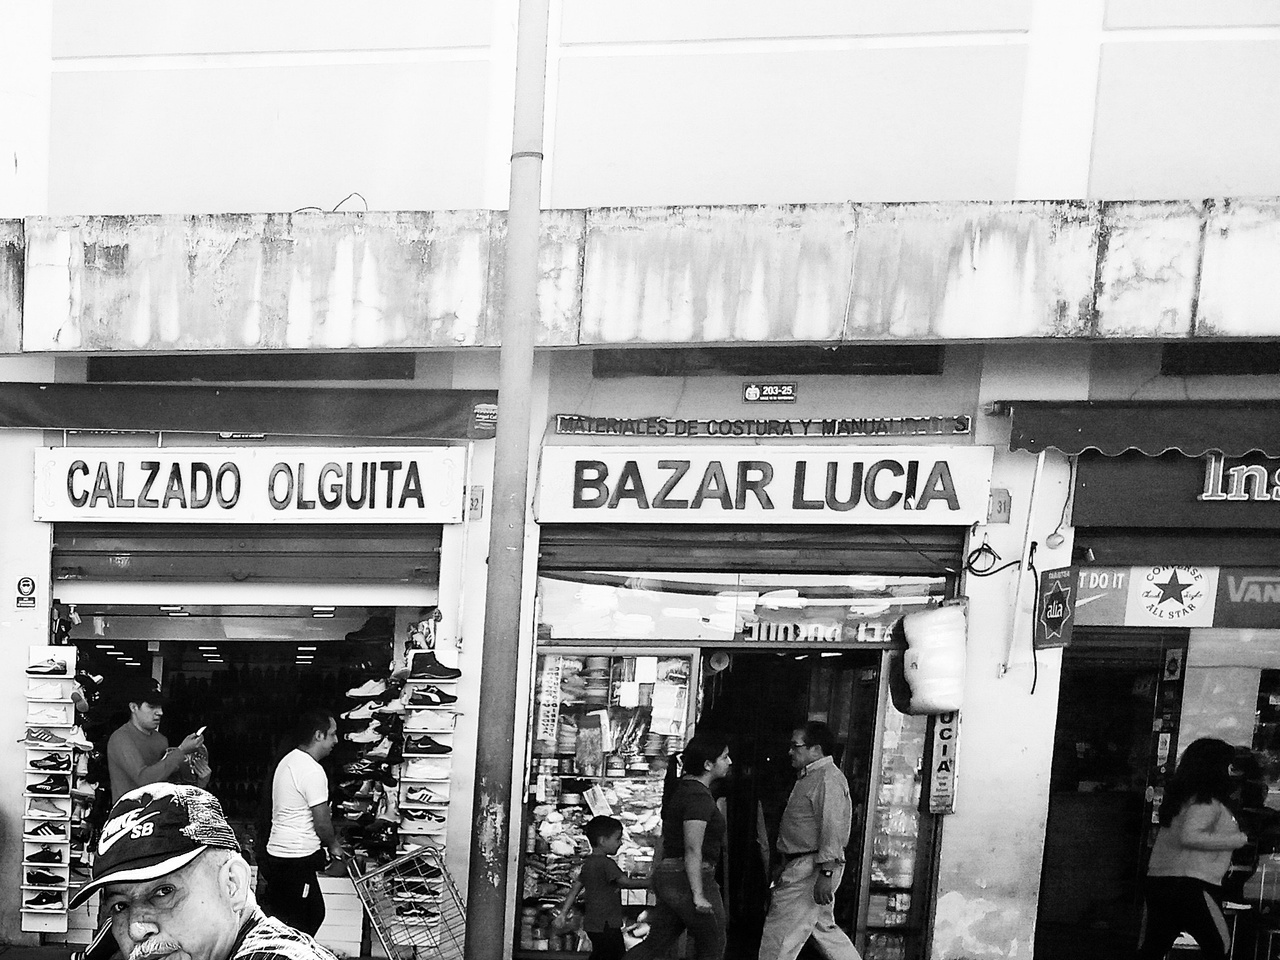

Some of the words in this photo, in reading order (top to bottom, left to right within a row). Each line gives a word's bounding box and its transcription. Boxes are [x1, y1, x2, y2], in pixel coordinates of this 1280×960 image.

[762, 385, 793, 395] 203-25
[559, 416, 669, 435] MATERIALES
[675, 419, 699, 435] DE
[707, 419, 794, 436] COSTURA
[799, 419, 812, 436] Y
[66, 459, 242, 510] CALZADO
[267, 460, 426, 511] OLGUITA
[572, 459, 775, 510] BAZAR
[791, 458, 961, 512] LUCIA
[1089, 572, 1109, 589] DO
[1112, 572, 1125, 589] IT
[1146, 603, 1164, 619] ALL
[1168, 603, 1196, 620] STAR
[129, 821, 155, 840] SB
